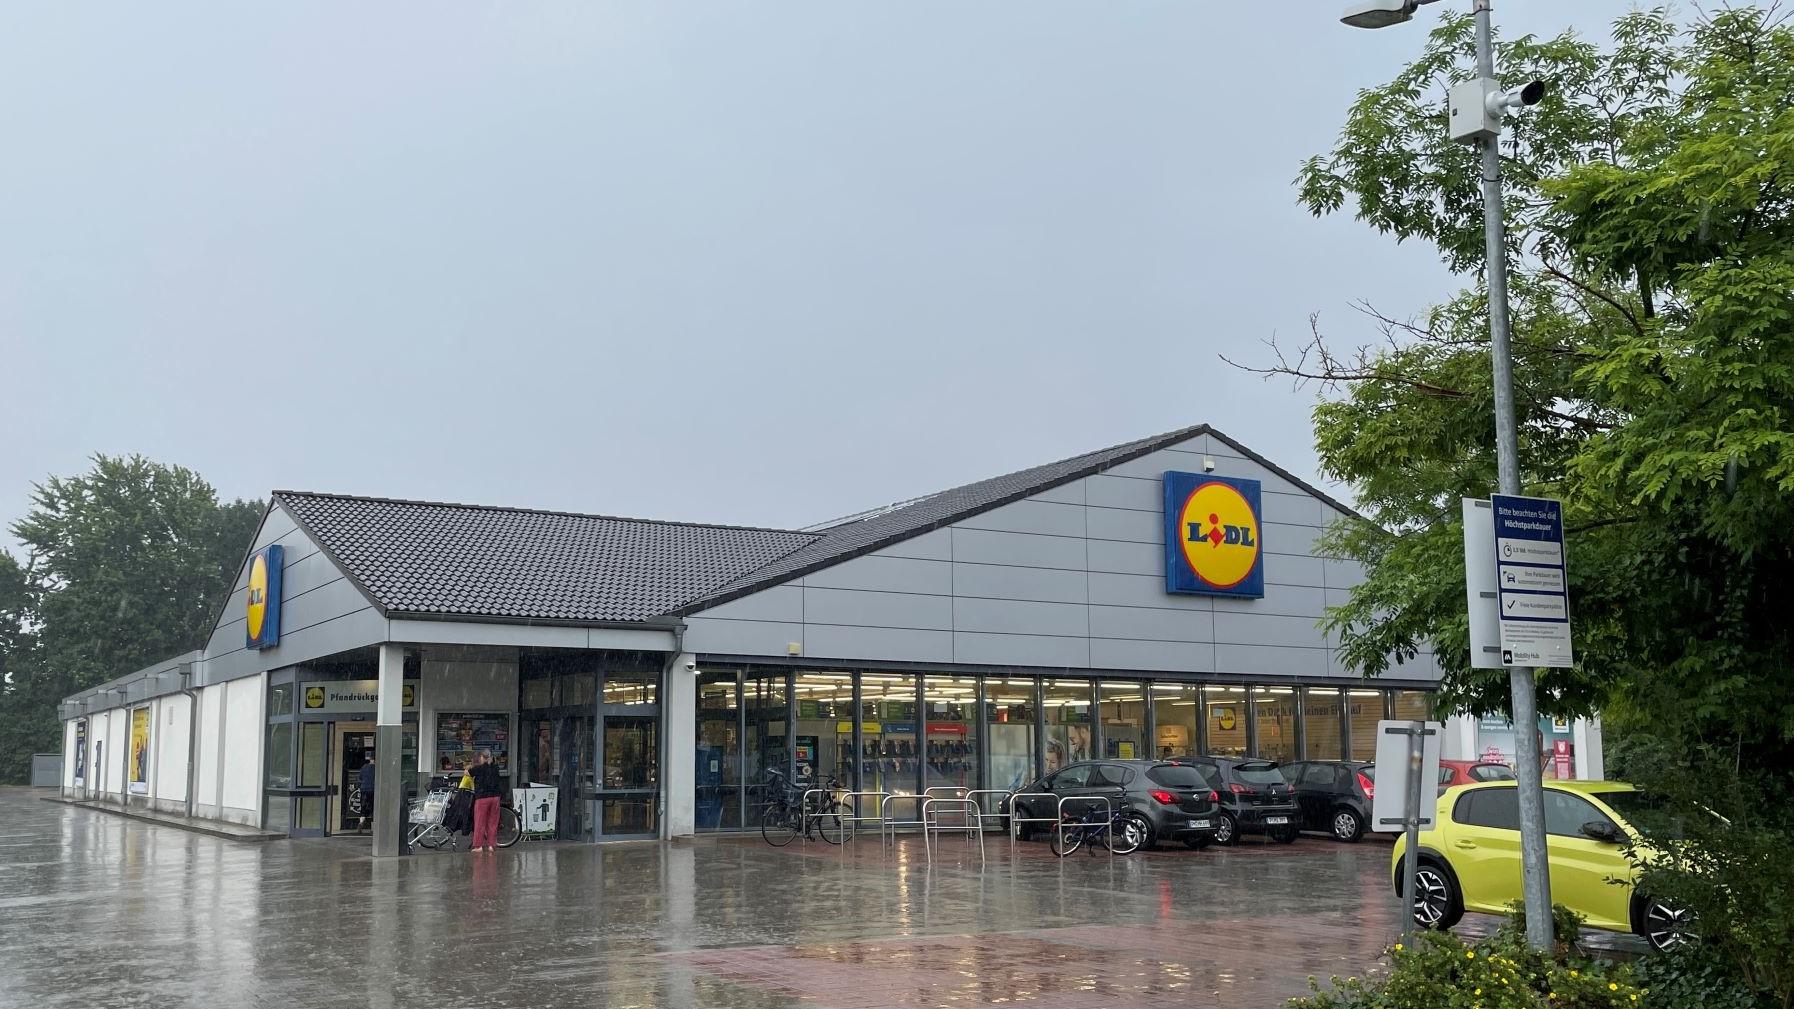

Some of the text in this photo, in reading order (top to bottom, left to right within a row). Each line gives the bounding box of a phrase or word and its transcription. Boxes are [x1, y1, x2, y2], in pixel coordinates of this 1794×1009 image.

[1499, 506, 1511, 516] Bitte
[1512, 508, 1537, 518] beachten
[1538, 511, 1547, 519] Sie
[1187, 514, 1254, 548] LIDL
[1505, 519, 1551, 531] Höchstparkdauer
[330, 692, 378, 703] Pfandrückga
